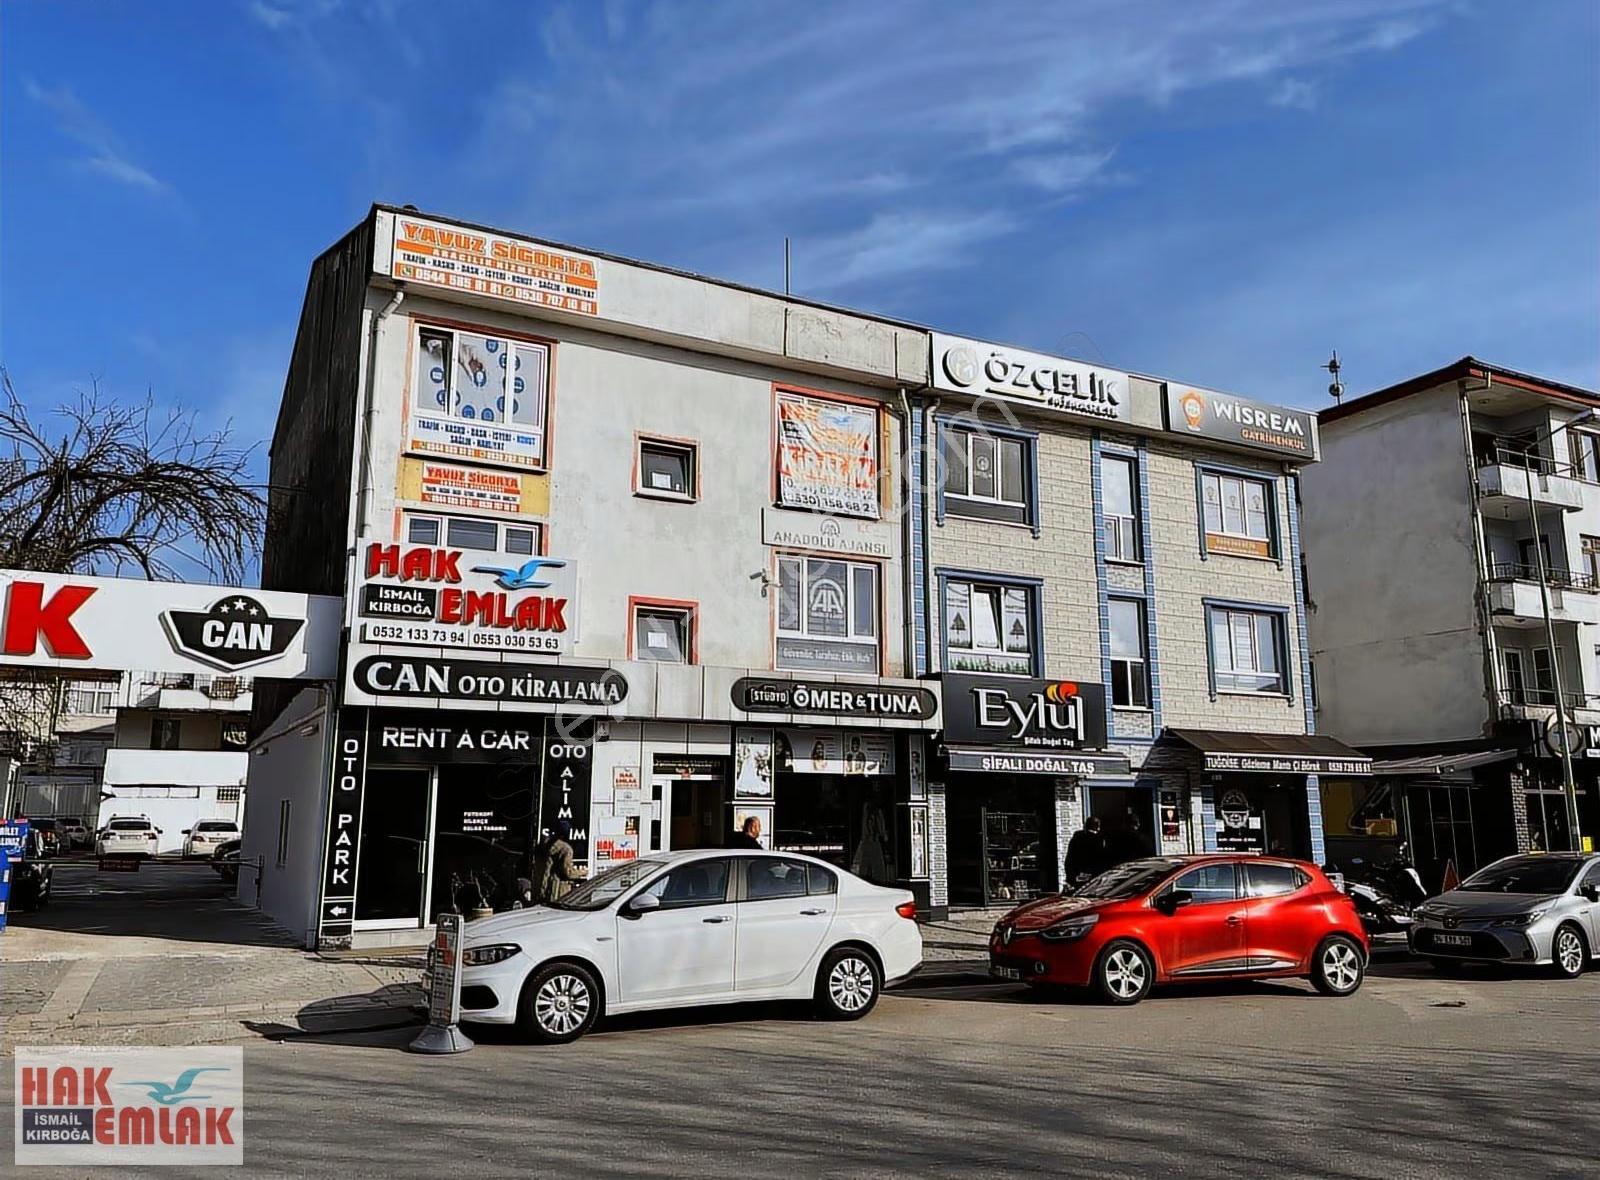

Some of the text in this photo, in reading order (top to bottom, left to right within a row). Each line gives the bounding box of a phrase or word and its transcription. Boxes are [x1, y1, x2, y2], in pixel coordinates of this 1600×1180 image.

[402, 221, 595, 280] YAVUZ SİGORTA
[984, 351, 1120, 406] ÖZÇELİK
[1213, 400, 1304, 436] WİSREM
[773, 531, 888, 555] ANADOLU AJANSI
[365, 542, 463, 584] HAK
[369, 600, 432, 616] KIRBOĞA
[379, 586, 424, 602] İSMAİL
[436, 587, 567, 633] EMLAK
[202, 619, 273, 651] CAN
[373, 626, 559, 650] 0532 133 73 94 0553 030 53 63
[366, 661, 621, 702] CAN OTO KİRALAMA
[382, 726, 530, 751] RENT A CAR
[549, 744, 587, 759] OTO
[982, 756, 1096, 775] ŞİFALI DOĞAL TAŞ
[557, 766, 574, 819] ALIM
[332, 739, 359, 885] OTO PARK
